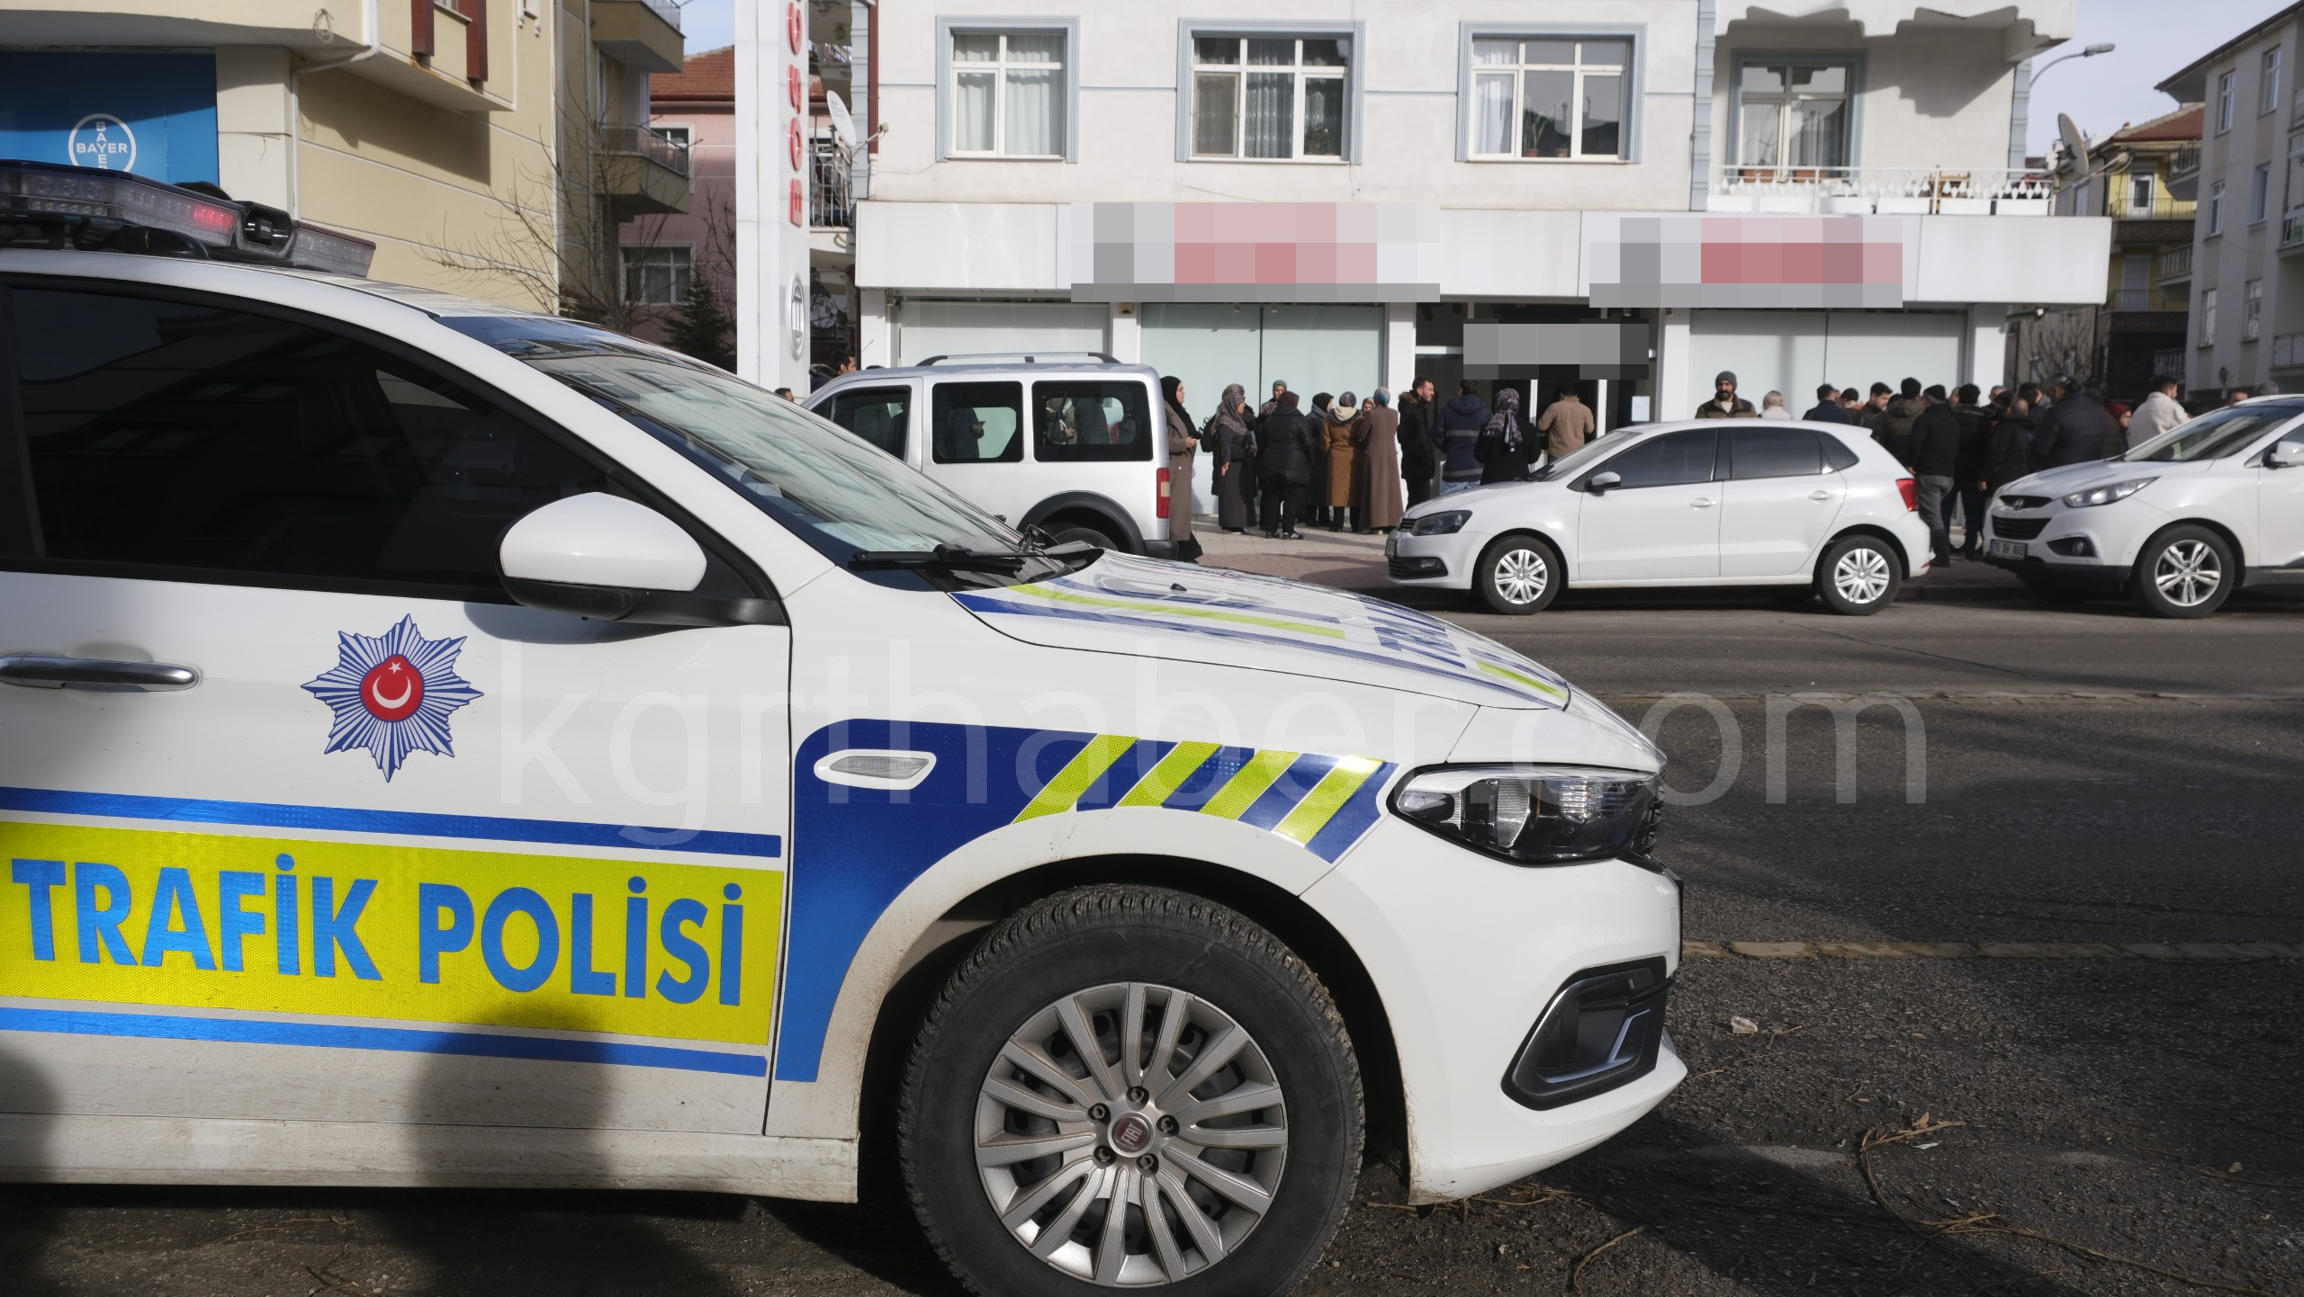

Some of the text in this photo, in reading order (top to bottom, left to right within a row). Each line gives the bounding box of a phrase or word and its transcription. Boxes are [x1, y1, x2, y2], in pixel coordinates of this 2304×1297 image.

[76, 143, 129, 153] BAYER
[788, 0, 802, 227] BOSC
[12, 853, 745, 1007] TRAFİK POLİSİ
[1120, 1122, 1143, 1146] FIAT
